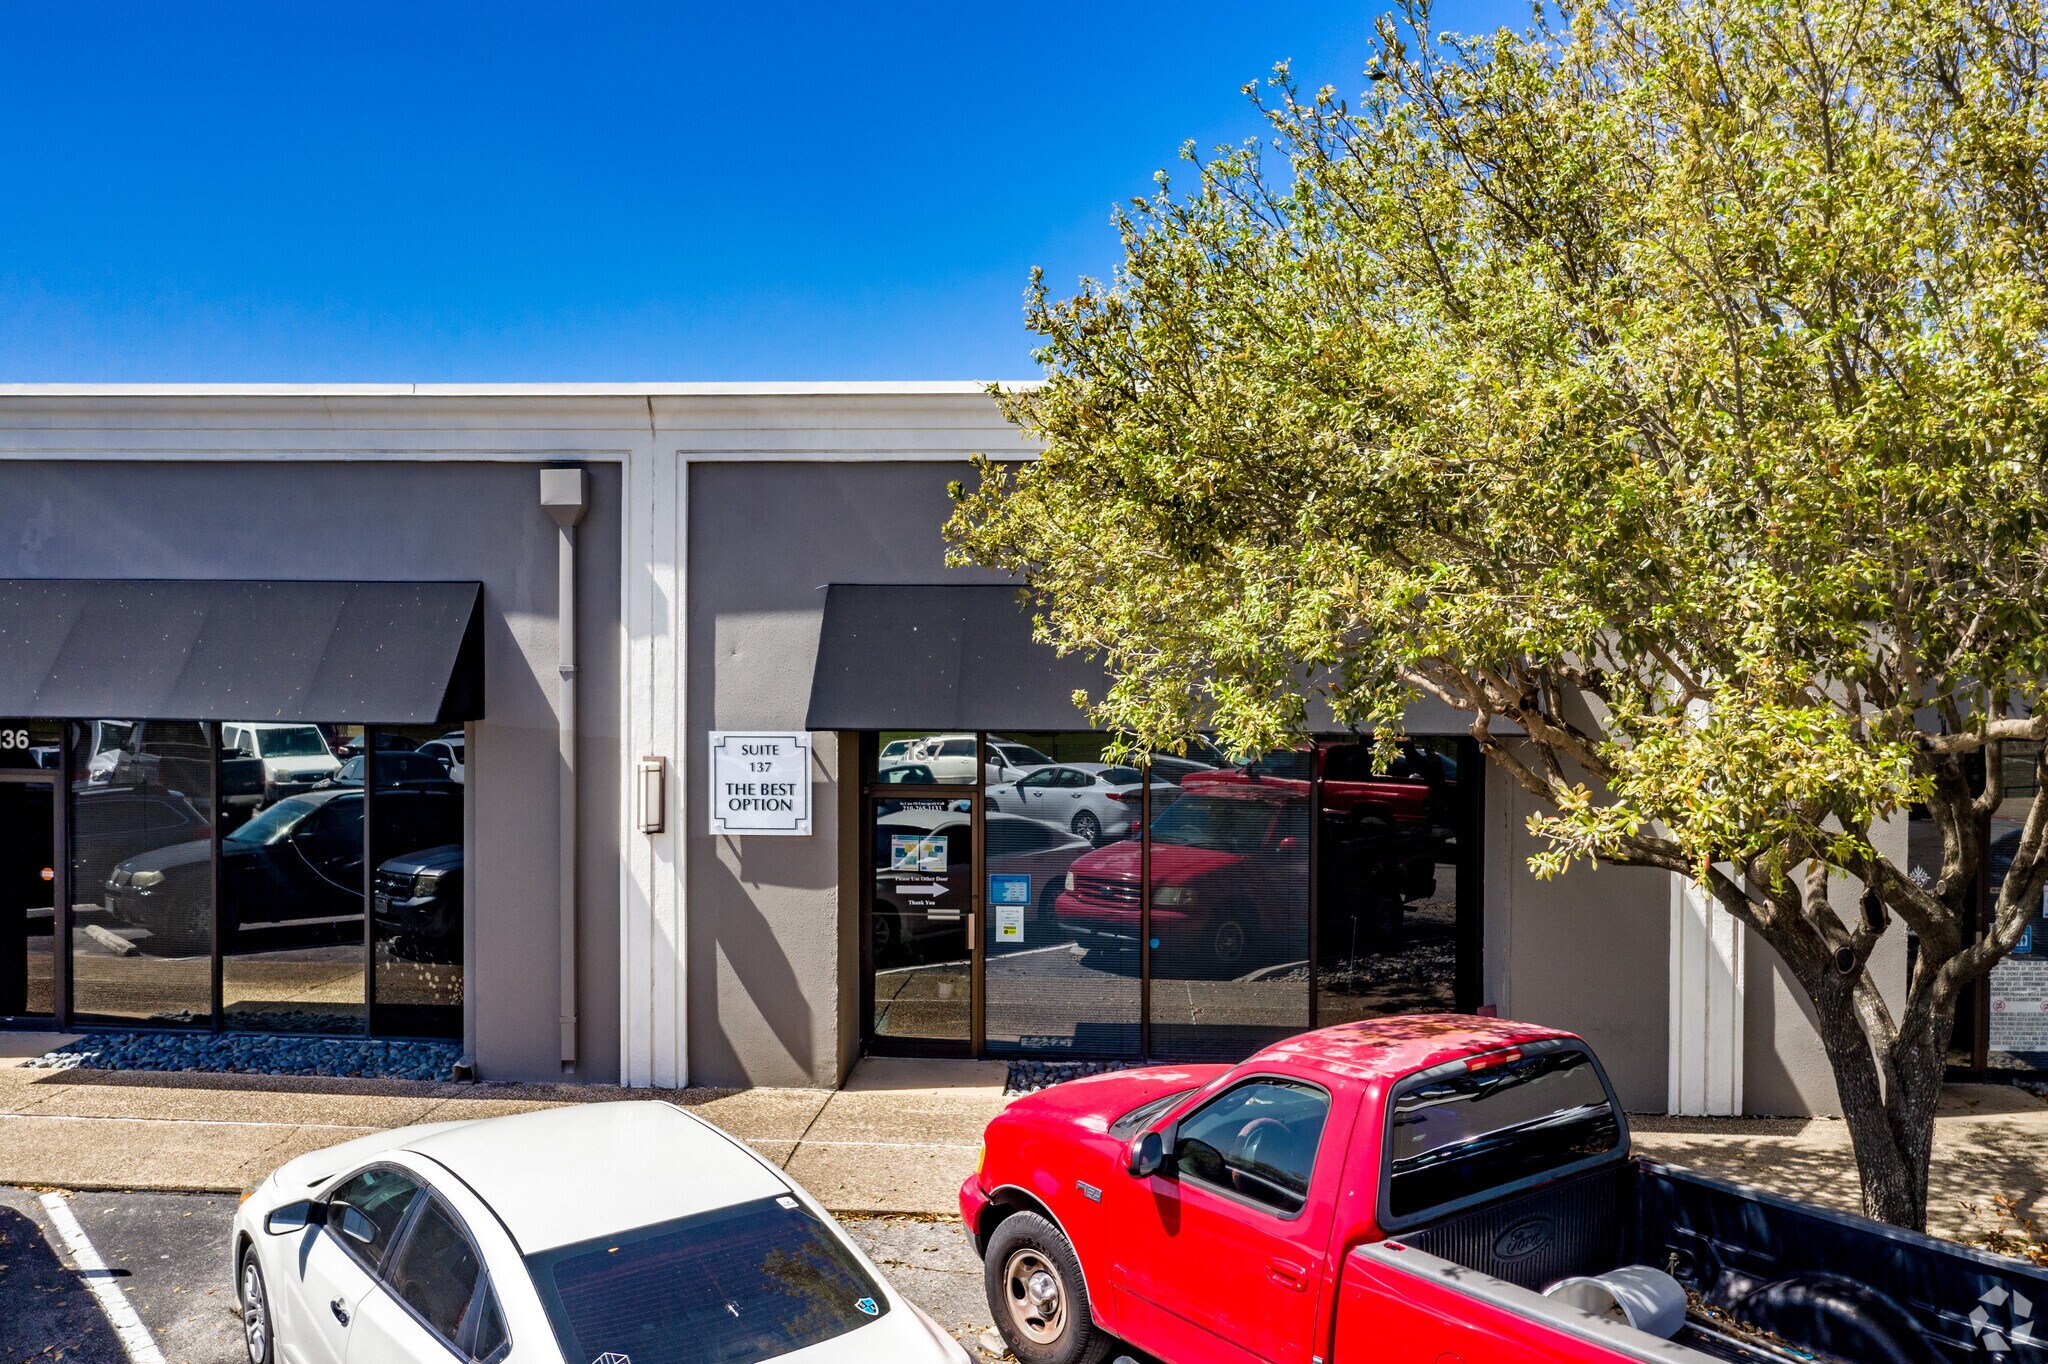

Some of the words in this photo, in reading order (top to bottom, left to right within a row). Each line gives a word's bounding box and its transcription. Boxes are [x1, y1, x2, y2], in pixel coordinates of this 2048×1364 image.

[741, 744, 780, 756] SUITE
[904, 741, 944, 761] 137
[750, 762, 772, 773] 137
[724, 782, 756, 796] THE
[760, 782, 797, 796] BEST
[728, 798, 793, 812] OPTION
[1506, 1230, 1541, 1254] Ford
